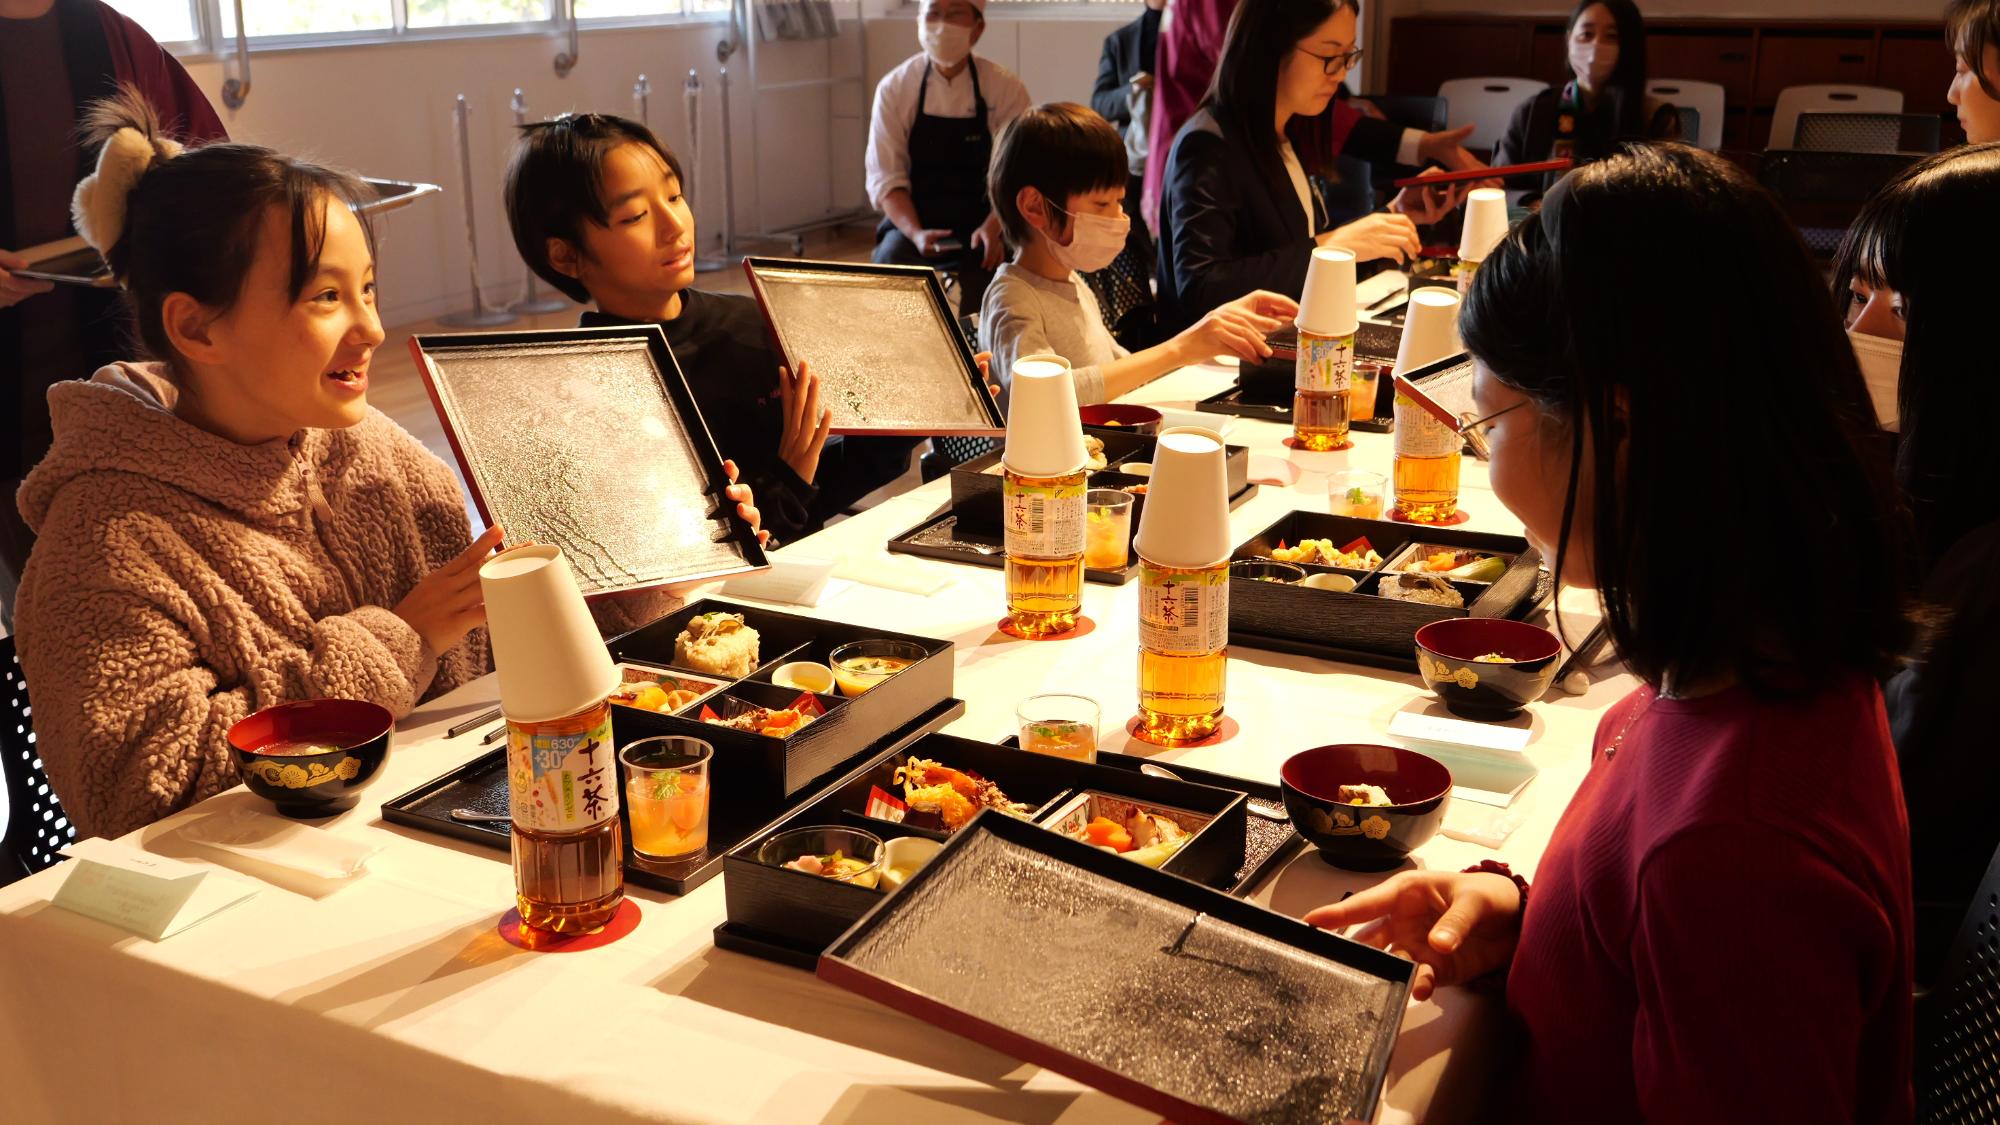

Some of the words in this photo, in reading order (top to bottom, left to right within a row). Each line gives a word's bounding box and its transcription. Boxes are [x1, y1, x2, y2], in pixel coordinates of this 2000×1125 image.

[1333, 344, 1347, 388] 十六茶
[1014, 491, 1027, 530] 十六茶
[1160, 580, 1179, 624] 十六茶
[577, 738, 609, 821] 十六茶
